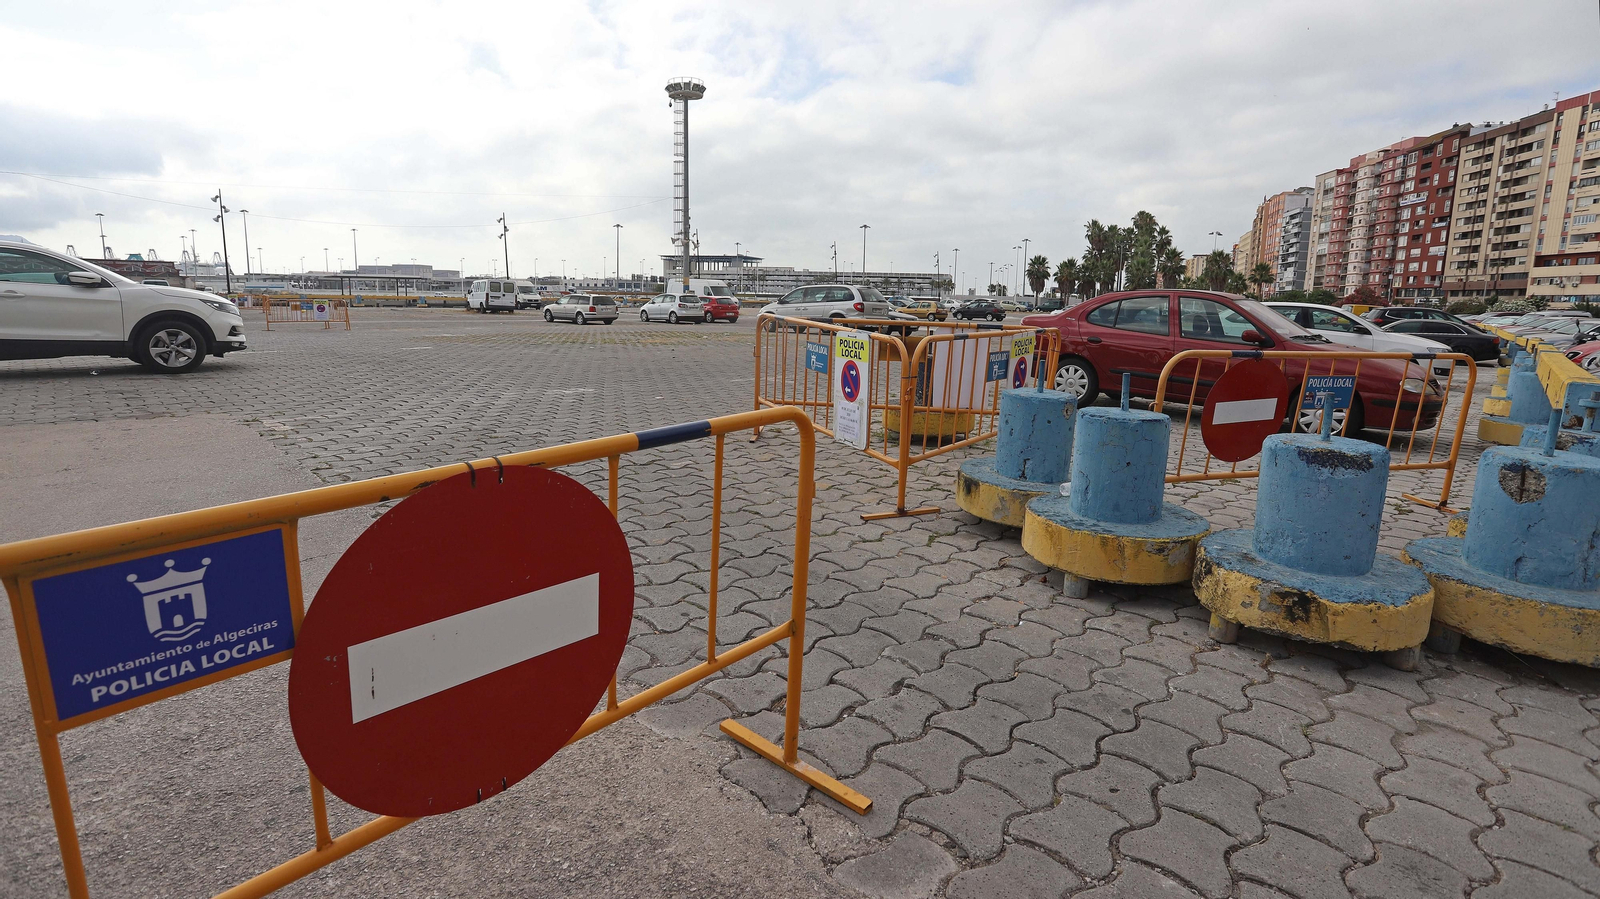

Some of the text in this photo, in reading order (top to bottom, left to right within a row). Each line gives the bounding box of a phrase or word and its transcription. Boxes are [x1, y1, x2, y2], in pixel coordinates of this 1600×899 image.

[839, 339, 865, 351] POLICIA
[1014, 338, 1032, 348] POLICIA
[841, 348, 862, 360] LOCAL
[1015, 346, 1030, 356] LOCAL
[1308, 377, 1353, 388] POLICÍA LOCAL
[71, 619, 279, 686] Ayuntamiento de Algeciras
[91, 636, 275, 703] POLICIA LOCAL
